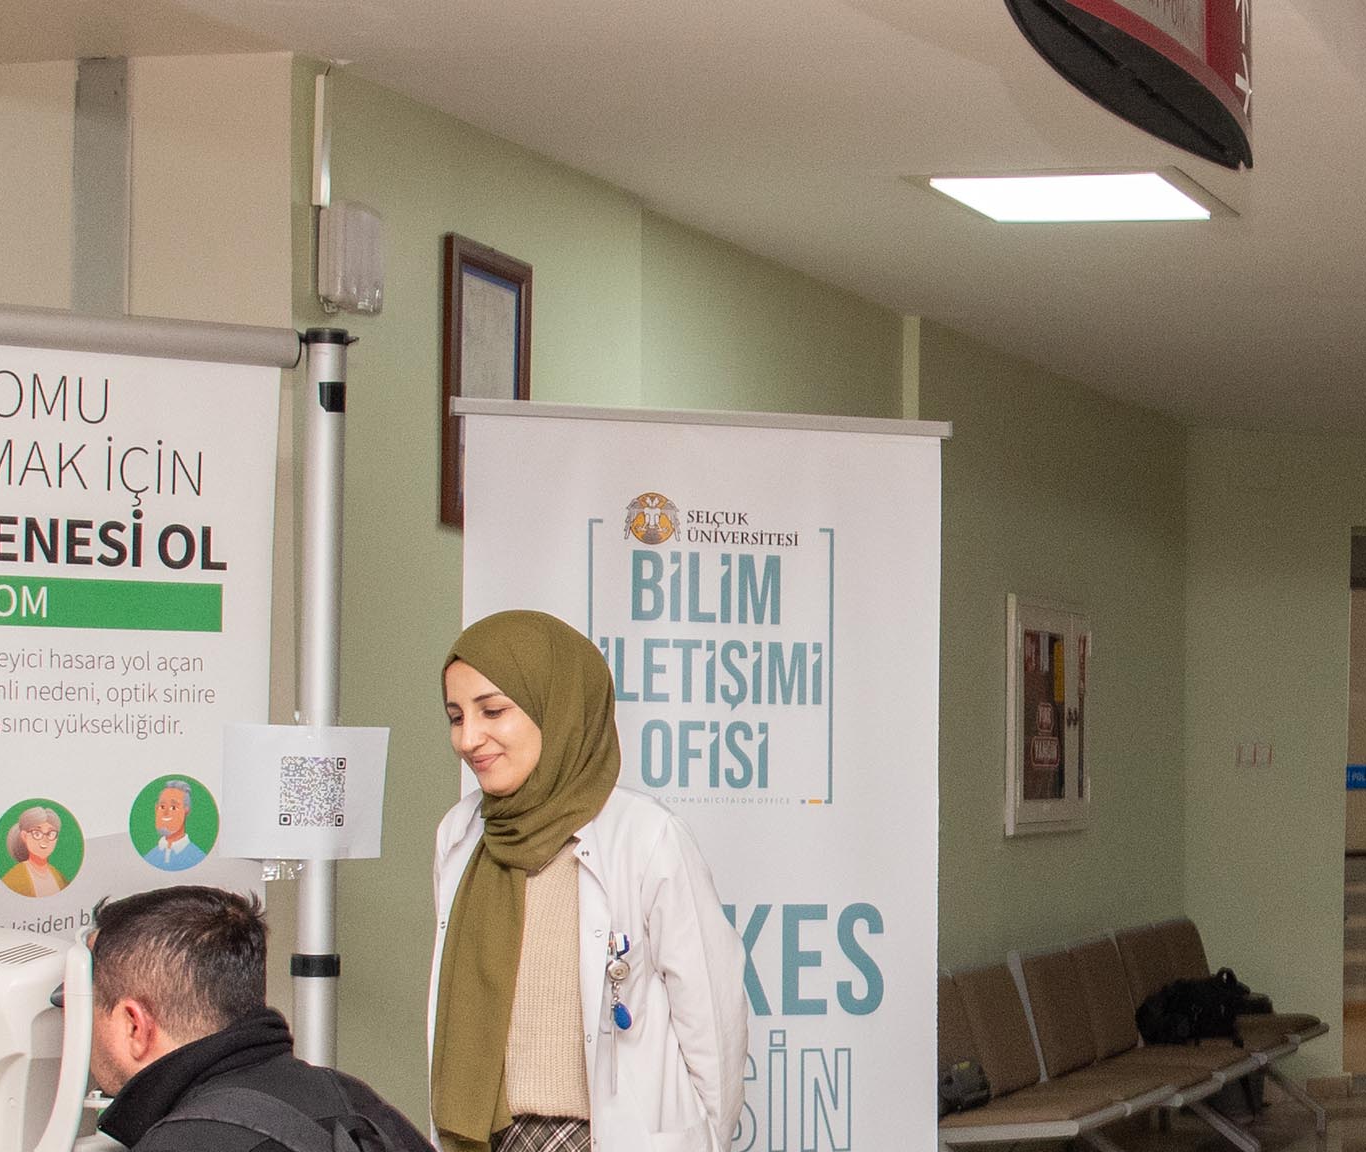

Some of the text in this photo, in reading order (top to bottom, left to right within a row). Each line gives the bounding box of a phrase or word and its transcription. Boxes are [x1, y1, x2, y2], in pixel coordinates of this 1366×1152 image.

[106, 435, 203, 508] İÇİN
[687, 510, 749, 527] SELÇUK
[157, 523, 227, 572] OL
[687, 527, 798, 546] ÜNİVERSİTESİ
[632, 550, 780, 625] BİLİM
[50, 648, 115, 671] hasara
[121, 651, 150, 676] yol
[157, 655, 204, 677] açan
[26, 680, 100, 705] nedeni,
[106, 683, 158, 707] optik
[163, 684, 215, 704] sinire
[55, 713, 183, 740] yüksekliğidir.
[641, 719, 769, 789] OFİSİ
